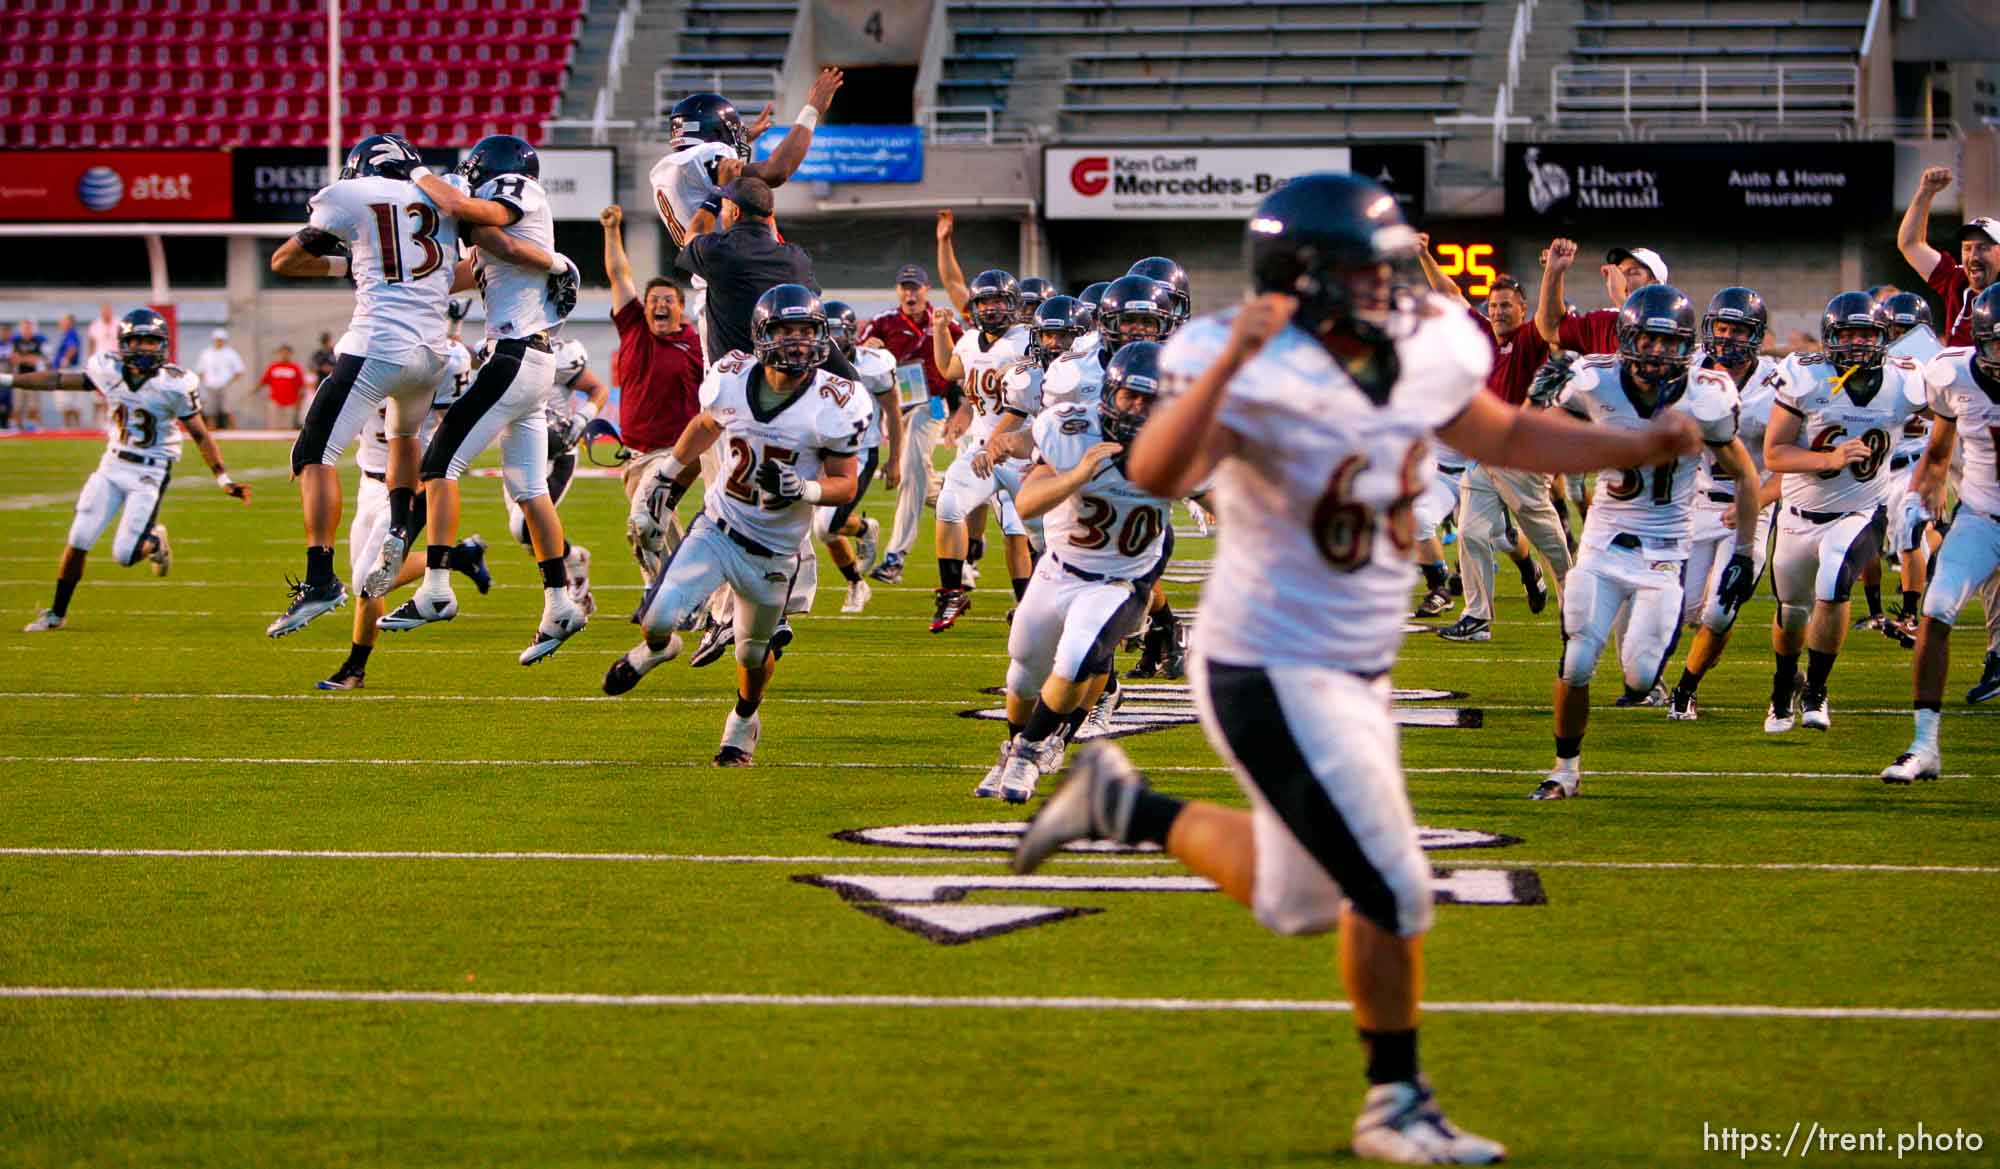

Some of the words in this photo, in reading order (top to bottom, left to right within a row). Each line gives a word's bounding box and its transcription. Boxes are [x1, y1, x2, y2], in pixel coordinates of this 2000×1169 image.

[863, 9, 883, 43] 4
[1113, 157, 1149, 173] Ken
[1152, 156, 1198, 173] Garff
[1577, 165, 1657, 189] Liberty
[1729, 169, 1771, 187] Auto
[1776, 170, 1790, 187] &
[1794, 170, 1846, 187] Home
[130, 173, 192, 200] at&t
[493, 177, 526, 199] H
[1745, 190, 1833, 207] Insurance
[364, 202, 444, 284] 13
[1437, 244, 1496, 296] 25
[452, 370, 471, 398] H
[819, 373, 855, 409] 25
[964, 366, 1005, 417] 49
[1067, 496, 1164, 558] 30
